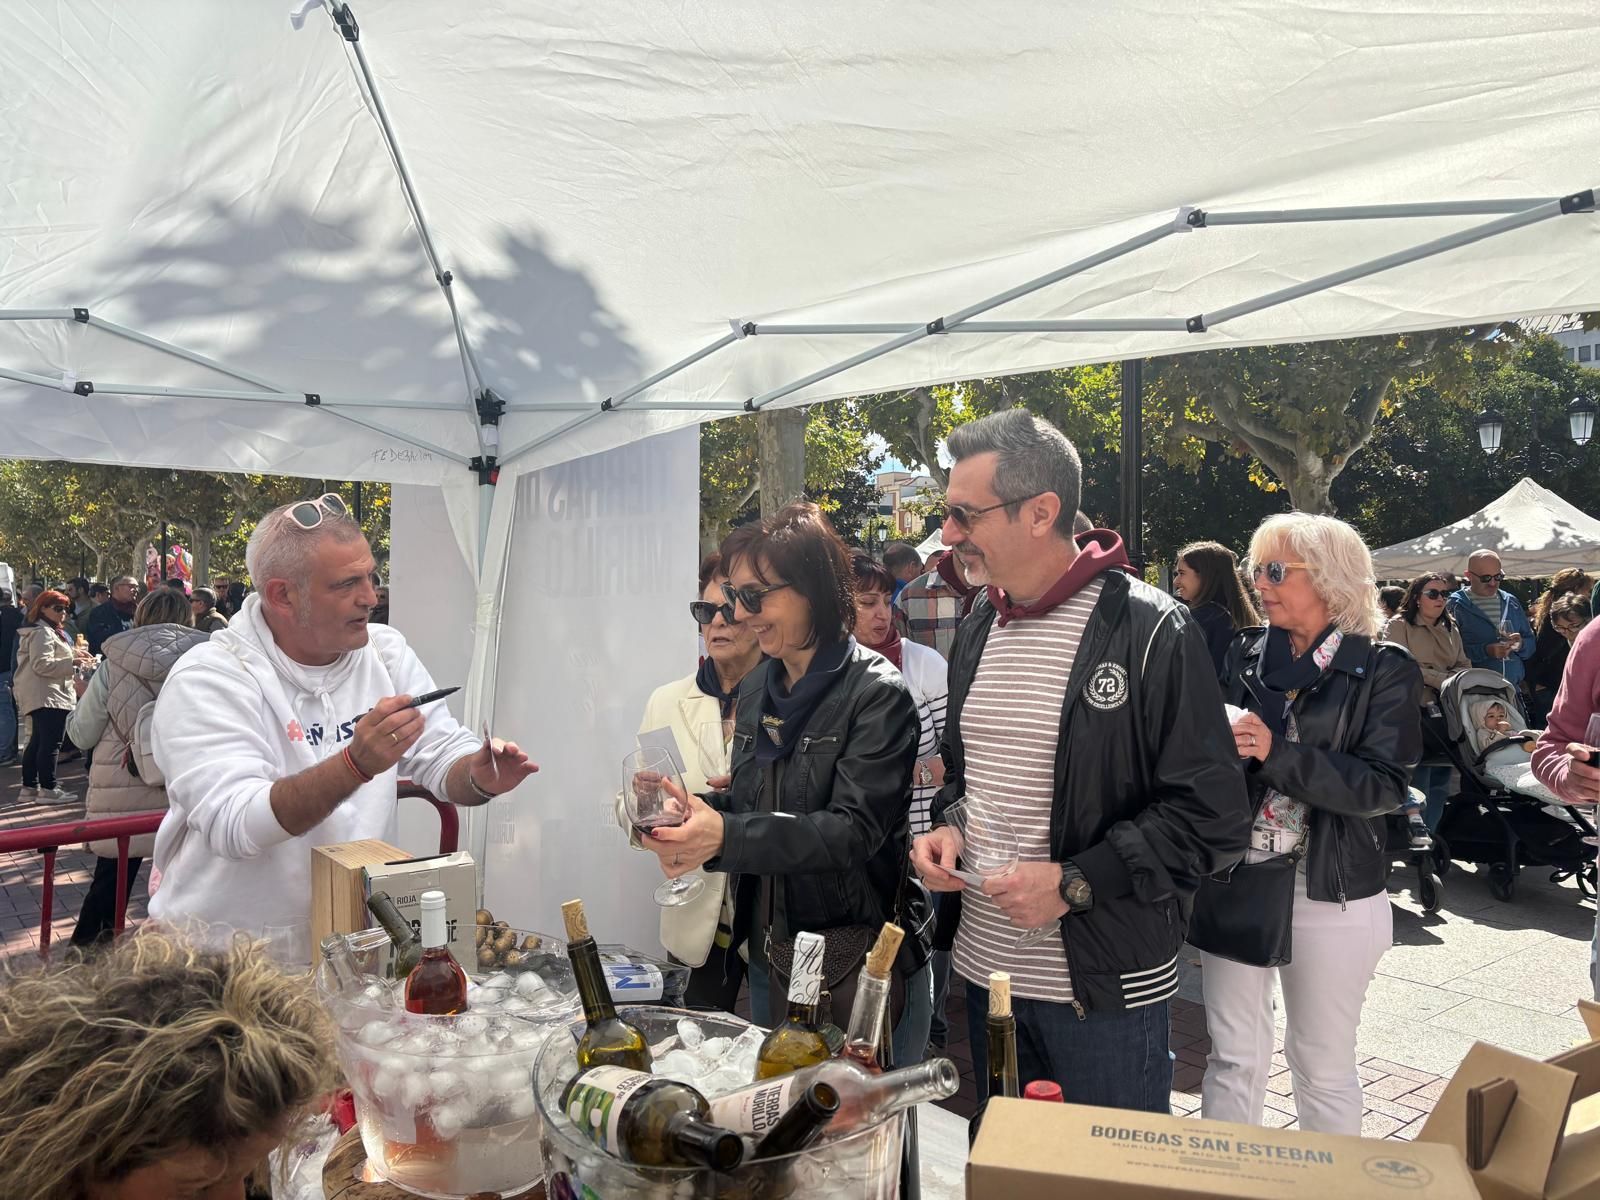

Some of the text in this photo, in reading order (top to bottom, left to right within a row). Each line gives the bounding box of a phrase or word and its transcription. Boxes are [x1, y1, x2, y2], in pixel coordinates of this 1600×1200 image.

[1097, 677, 1115, 693] 72
[397, 895, 416, 905] RIOJA
[752, 1088, 768, 1131] MURILLO
[766, 1084, 783, 1127] TIERRAS
[1091, 1125, 1183, 1147] BODEGAS
[1188, 1136, 1230, 1152] SAN
[1236, 1141, 1334, 1165] ESTEBAN
